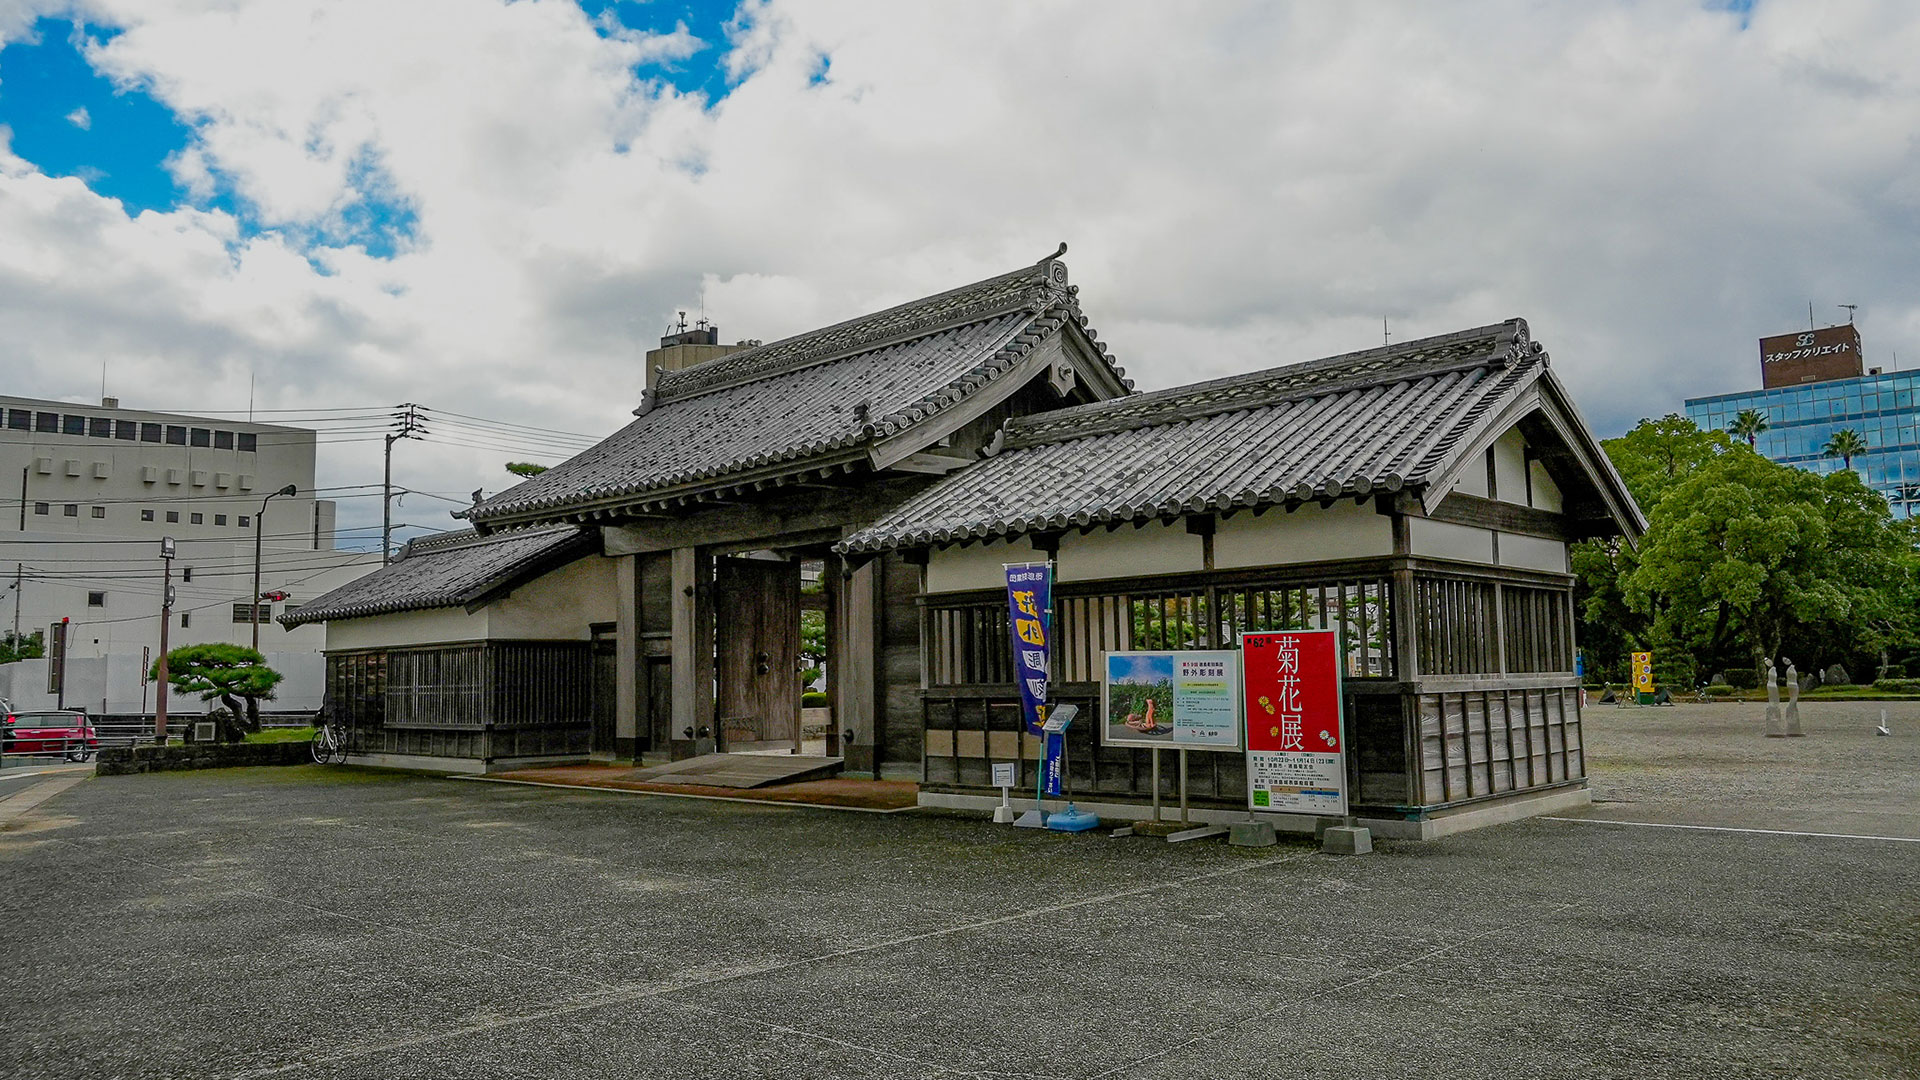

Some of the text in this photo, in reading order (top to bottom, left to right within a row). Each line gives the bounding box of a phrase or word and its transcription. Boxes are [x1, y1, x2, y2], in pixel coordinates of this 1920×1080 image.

[1765, 342, 1850, 363] スタッフクリエイト
[1275, 636, 1304, 751] 菊花展
